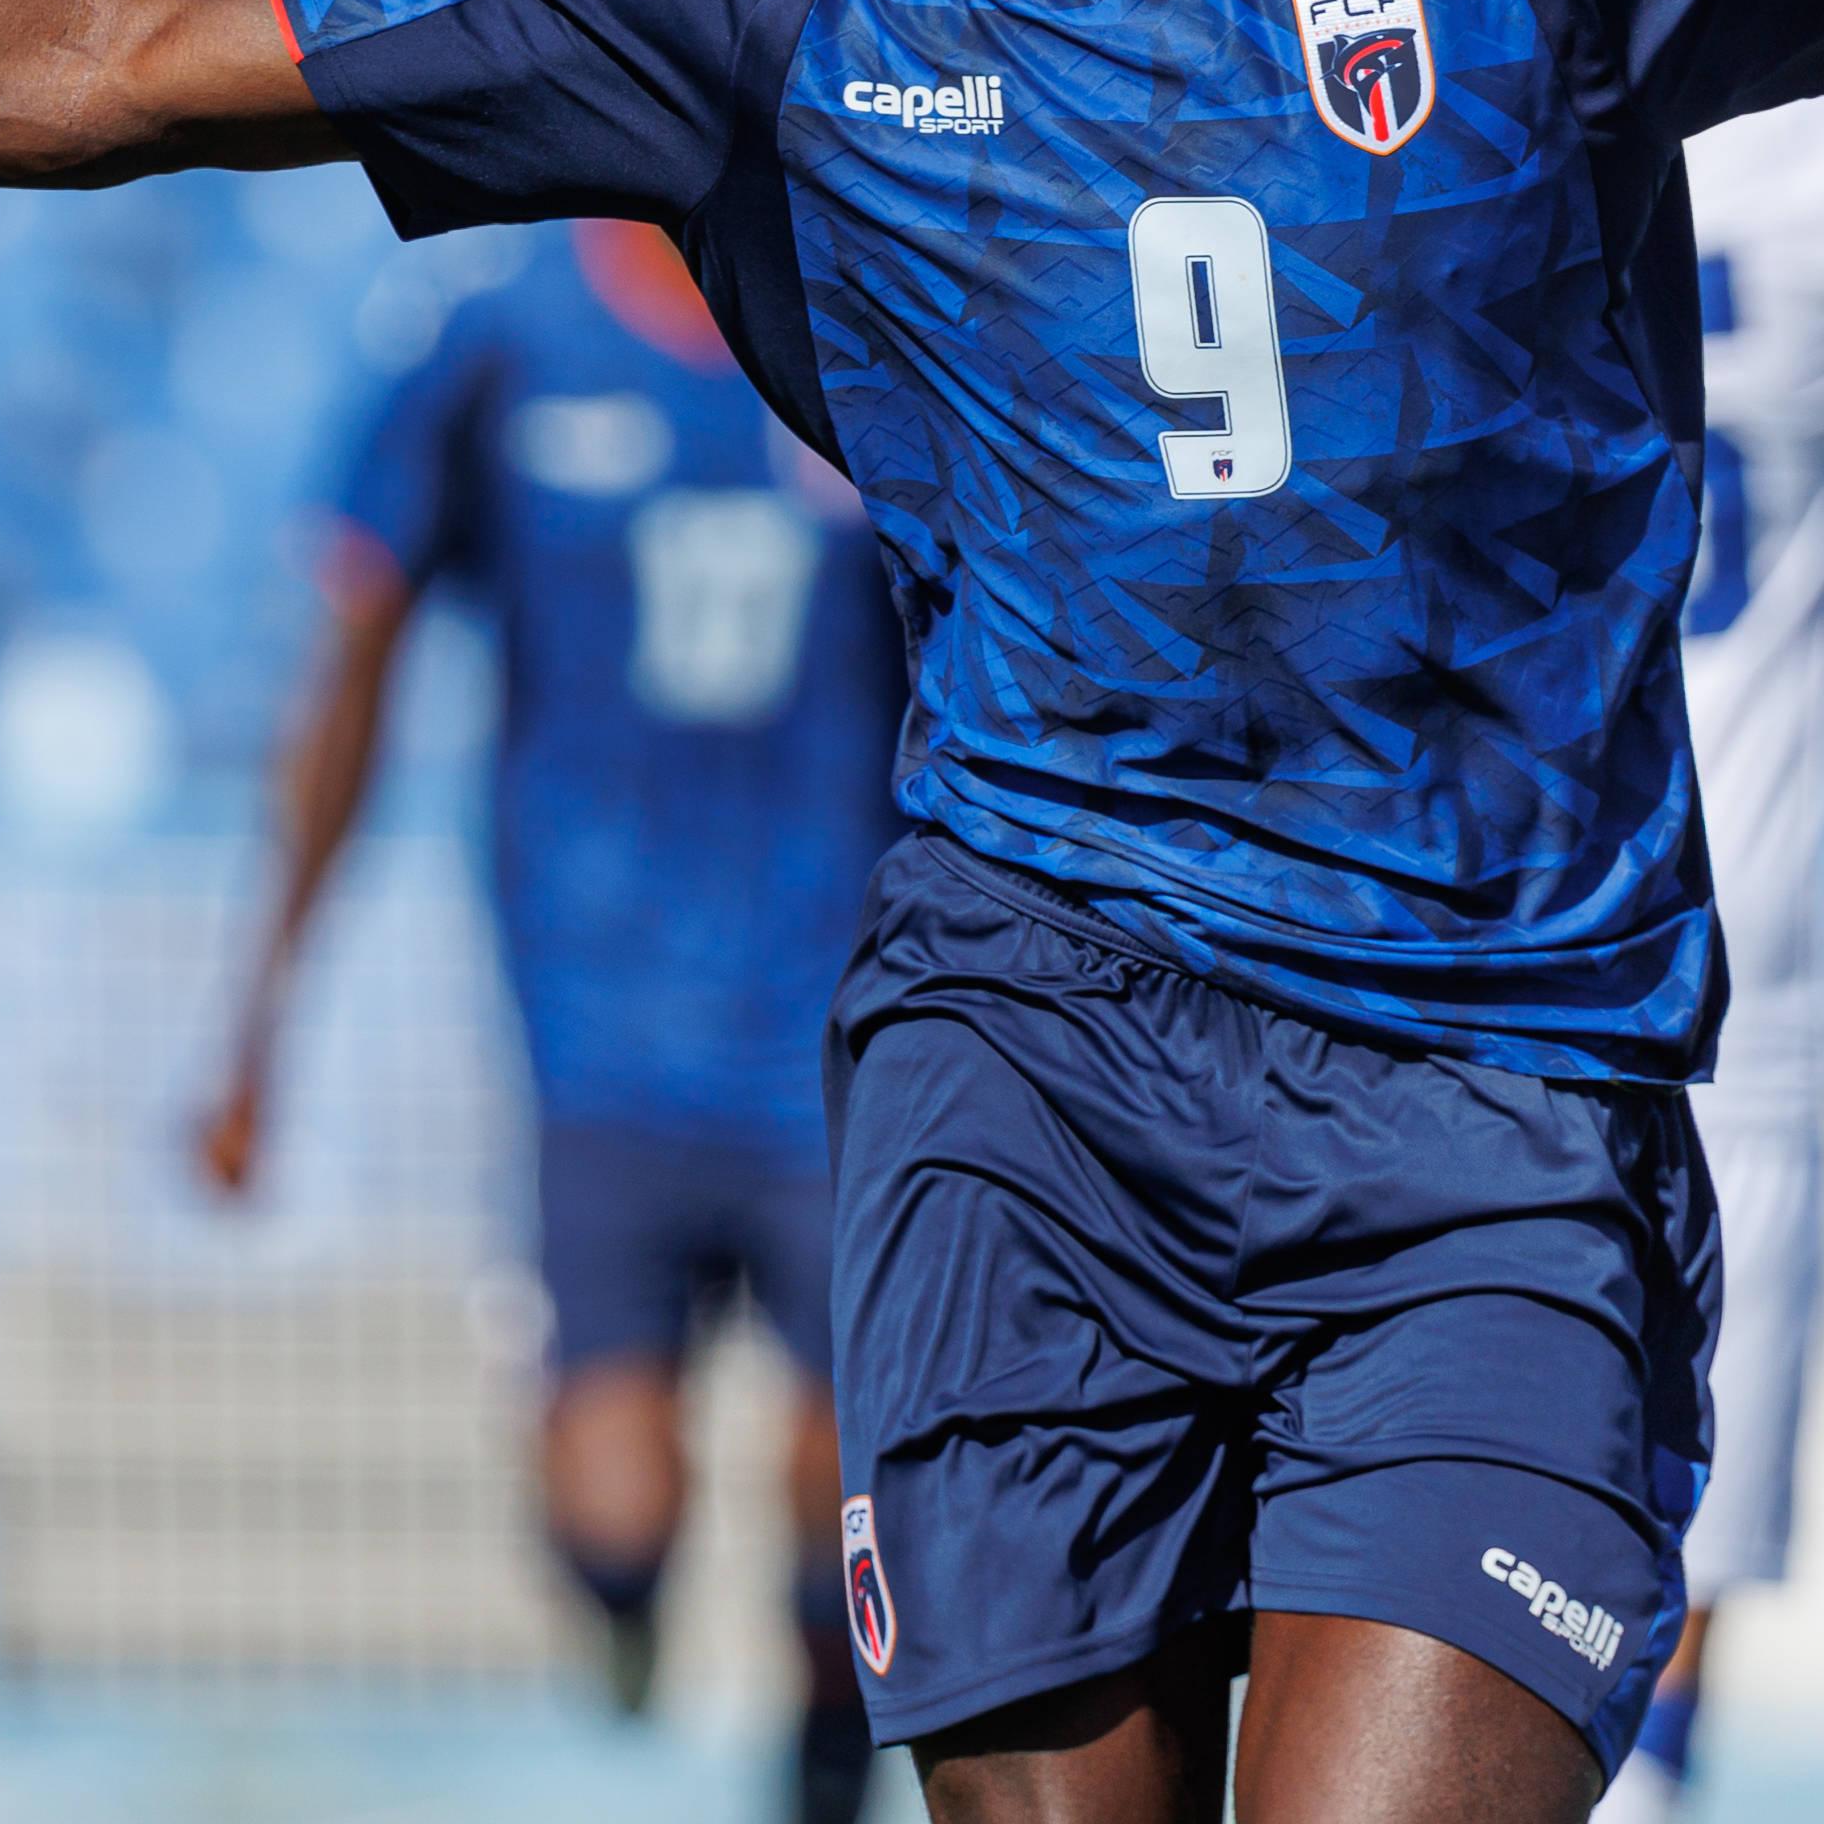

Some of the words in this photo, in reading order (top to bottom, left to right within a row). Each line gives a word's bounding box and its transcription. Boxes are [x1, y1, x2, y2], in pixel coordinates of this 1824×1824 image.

[843, 75, 1004, 128] capelli
[918, 117, 1004, 135] SPORT
[1128, 196, 1292, 500] 9
[1481, 1547, 1624, 1667] capelli
